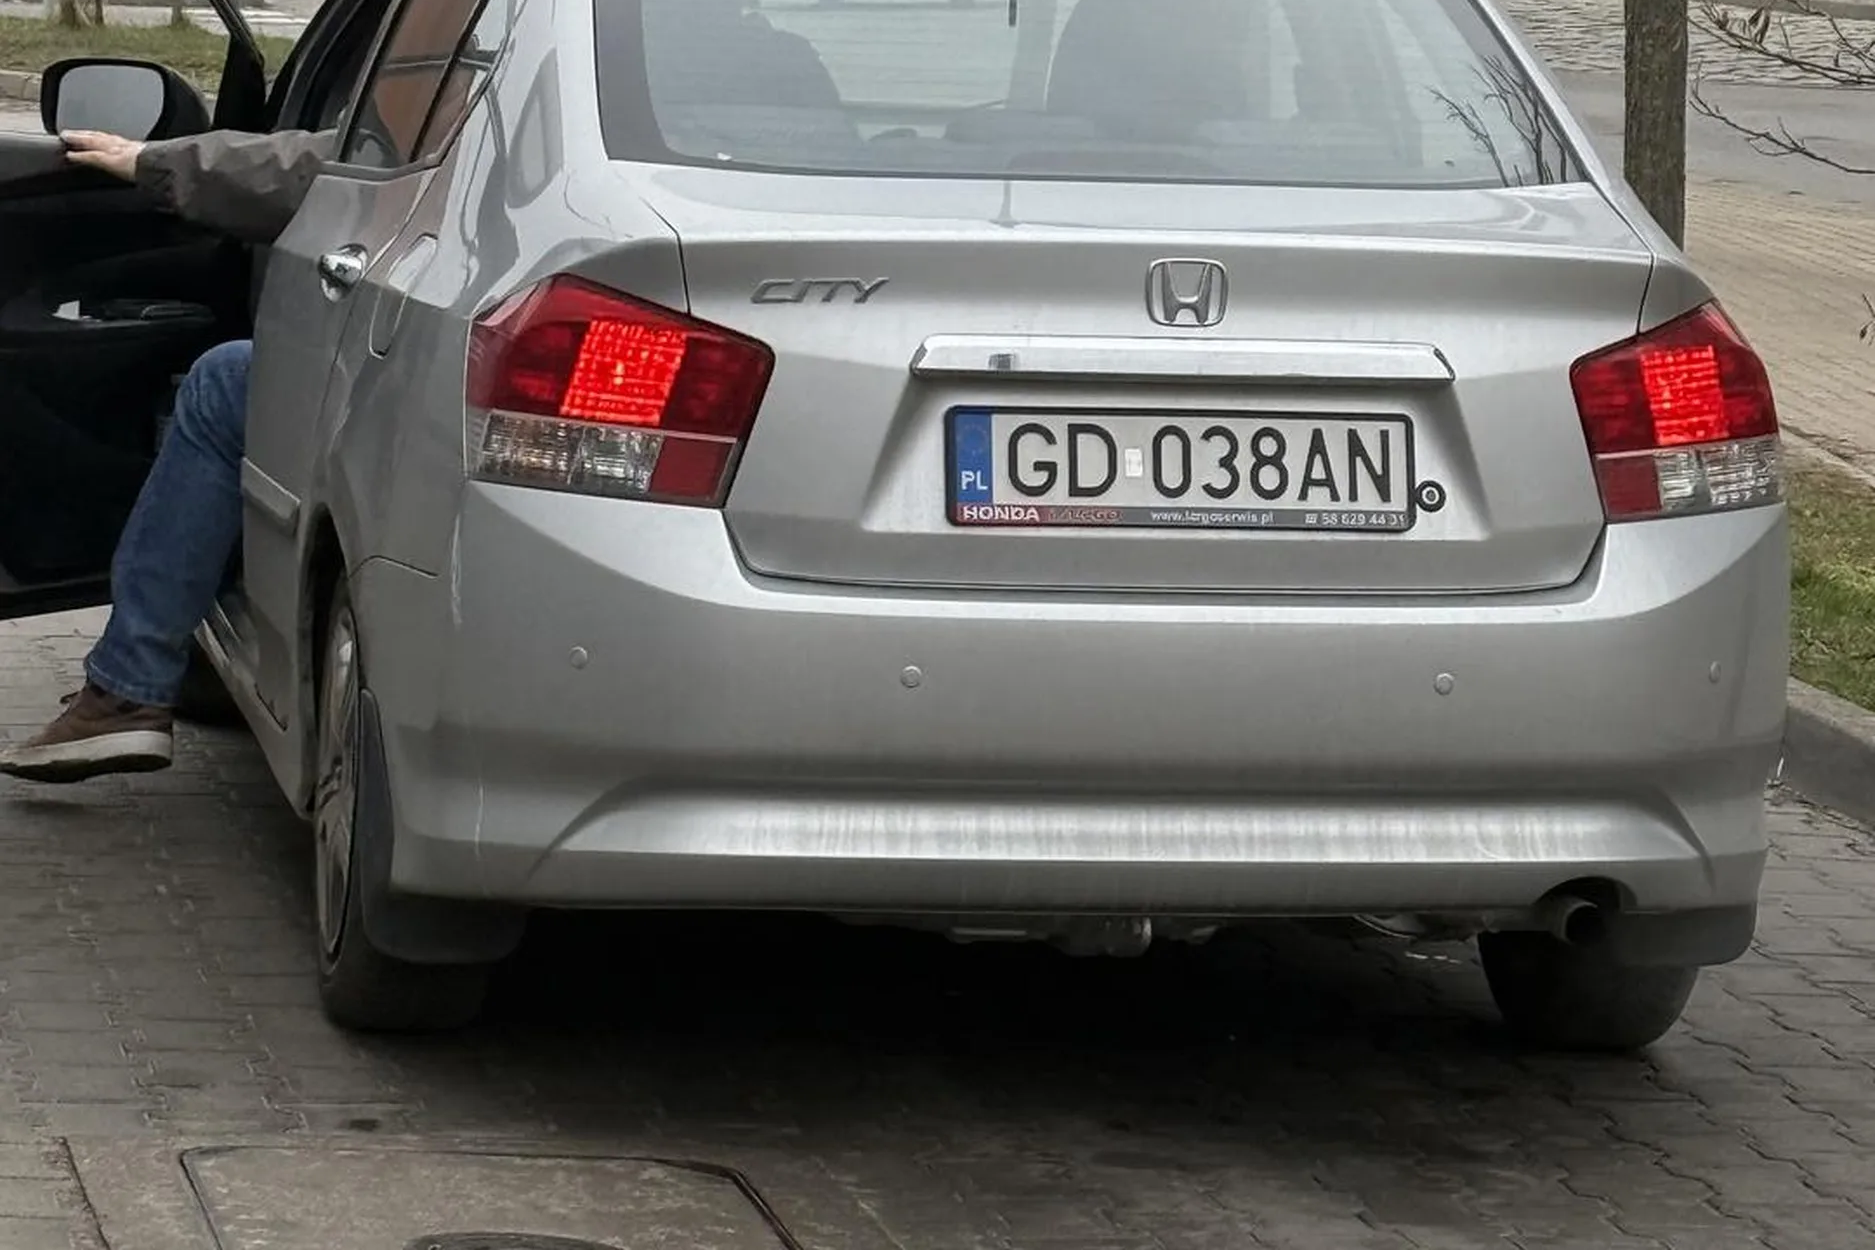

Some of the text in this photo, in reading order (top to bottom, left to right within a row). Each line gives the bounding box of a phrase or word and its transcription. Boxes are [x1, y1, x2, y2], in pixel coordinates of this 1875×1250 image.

[750, 277, 889, 304] CITY
[1007, 422, 1392, 503] GD 038AN
[961, 470, 988, 491] PL
[962, 505, 1040, 522] HONDA
